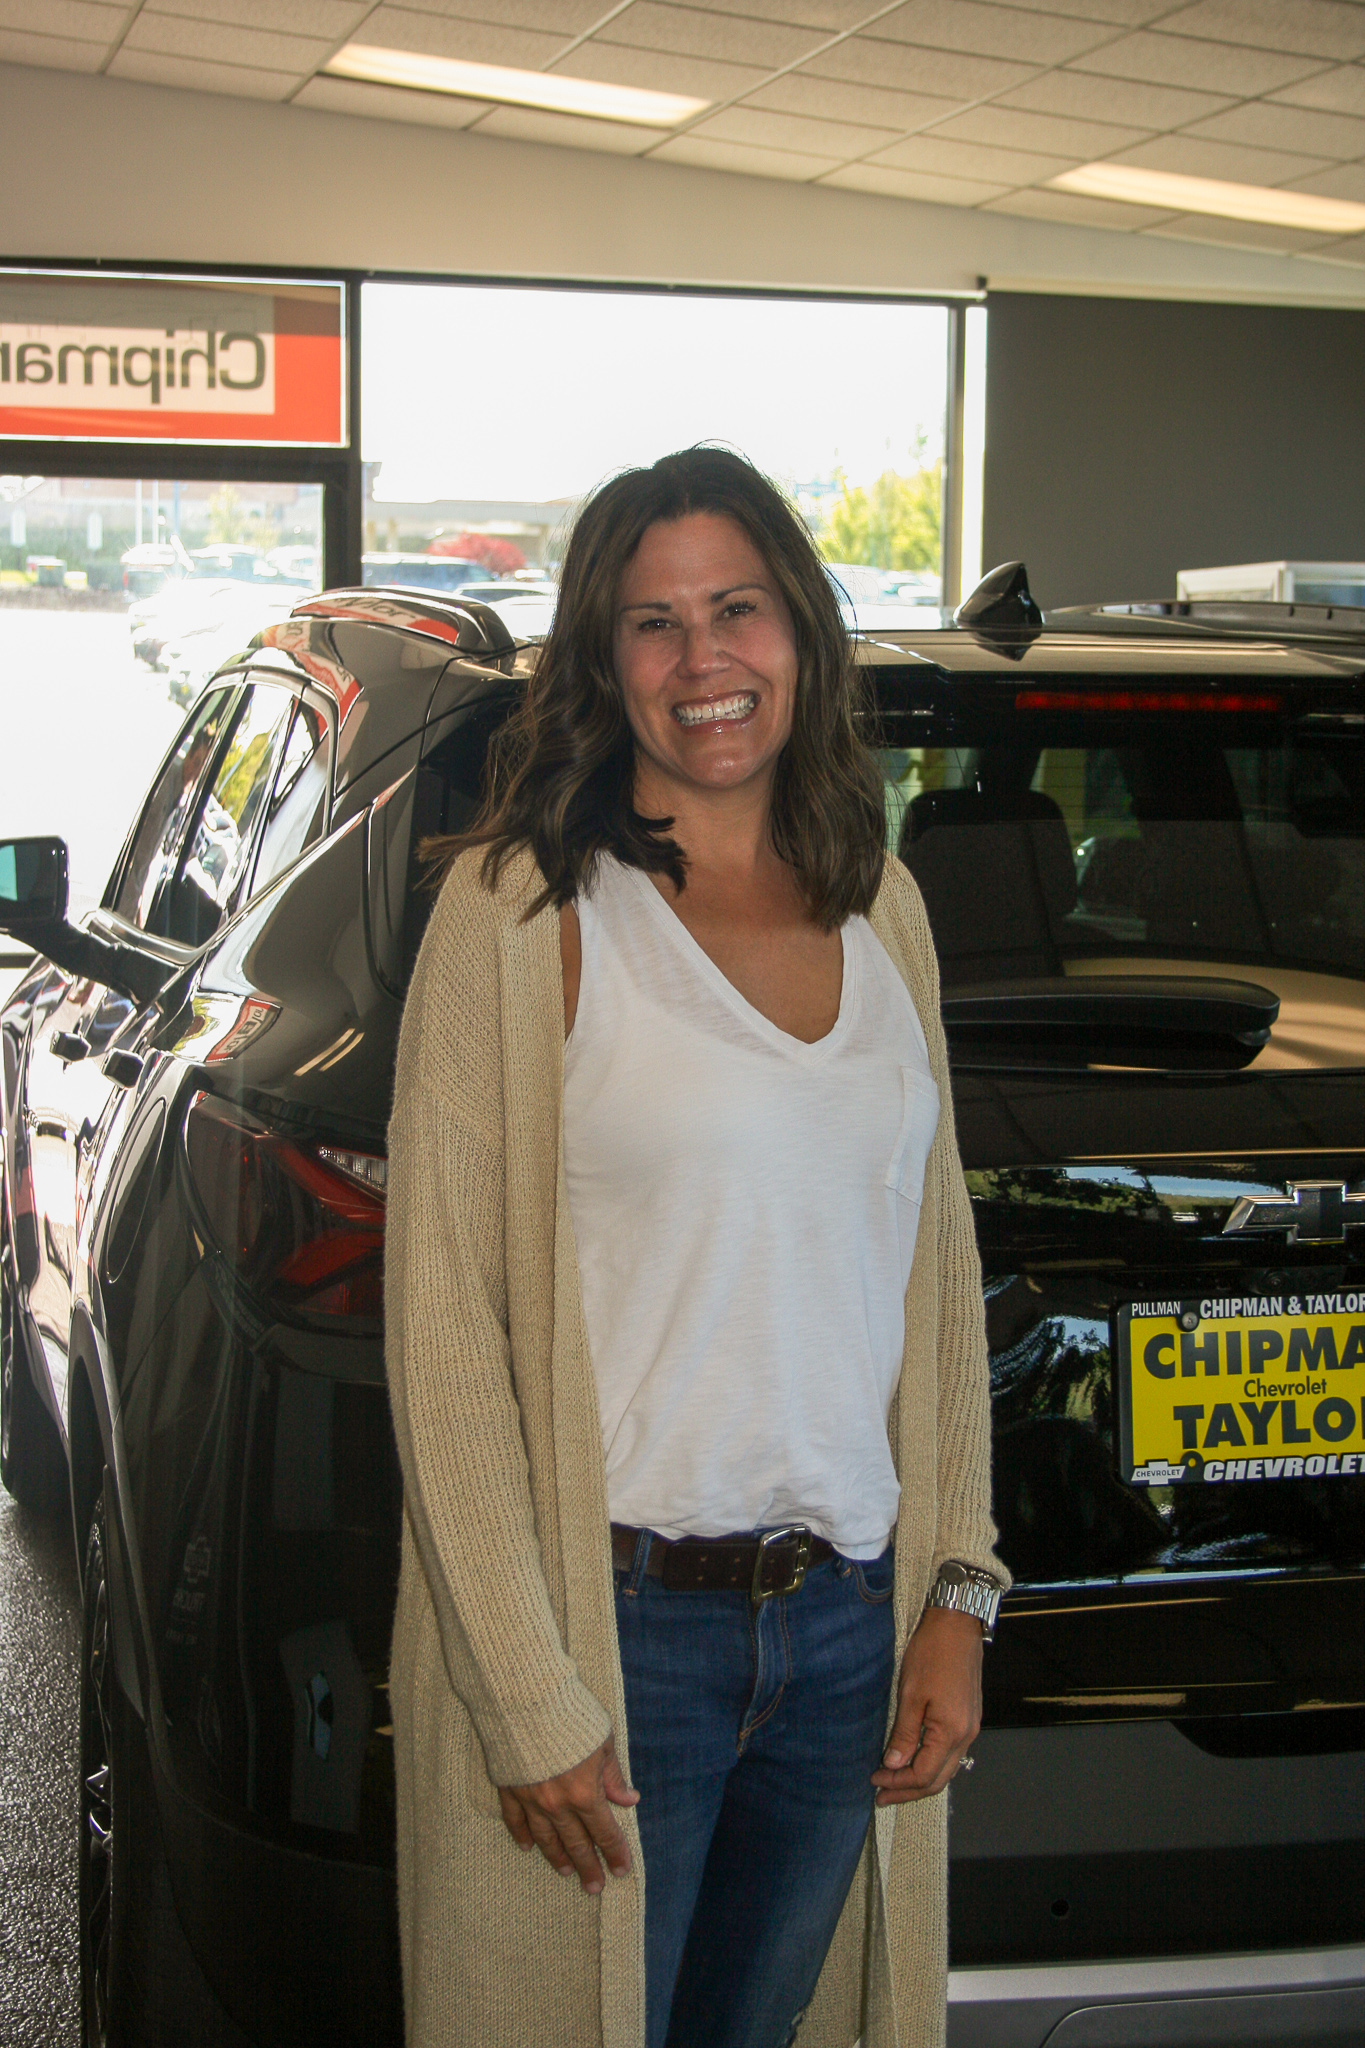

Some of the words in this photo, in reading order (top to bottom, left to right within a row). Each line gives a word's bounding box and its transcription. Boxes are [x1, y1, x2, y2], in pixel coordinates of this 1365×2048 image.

[1132, 1301, 1180, 1316] PULLMAN
[1200, 1297, 1282, 1318] CHIPMAN
[1287, 1297, 1301, 1315] &
[1244, 1376, 1327, 1397] Chevrolet
[1173, 1397, 1365, 1449] TAYLO
[1136, 1469, 1180, 1477] CHEVROLET
